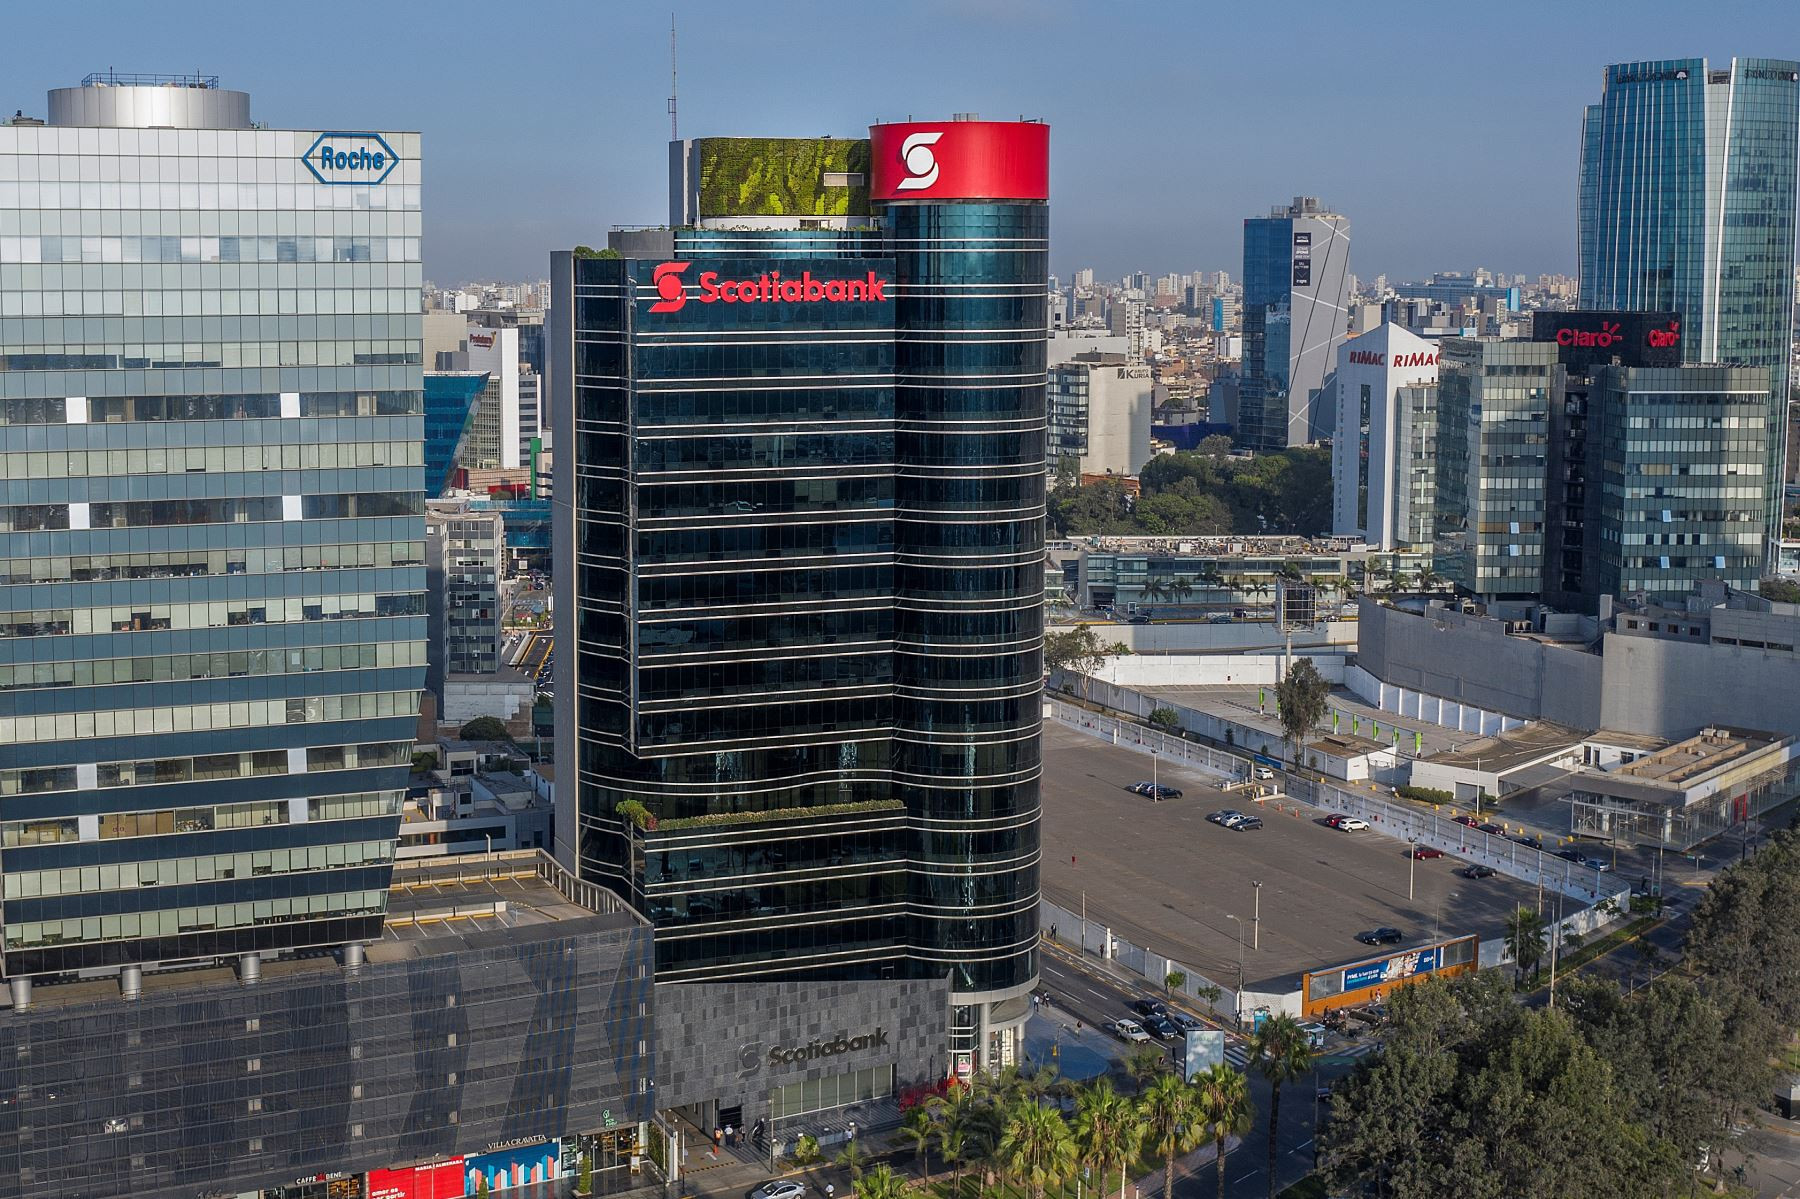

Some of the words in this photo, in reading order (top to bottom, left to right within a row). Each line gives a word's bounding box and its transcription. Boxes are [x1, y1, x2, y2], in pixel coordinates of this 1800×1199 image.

[321, 145, 385, 170] Roche
[699, 271, 887, 303] Scotiabank
[1556, 328, 1612, 347] Claro
[1648, 329, 1675, 347] Claro
[1349, 350, 1385, 366] RIMAC
[1126, 369, 1150, 379] KURIA
[768, 1027, 889, 1068] Scotiabank
[488, 1140, 510, 1150] VILLA
[510, 1134, 548, 1147] CRAVATTA
[325, 1171, 342, 1180] BENE
